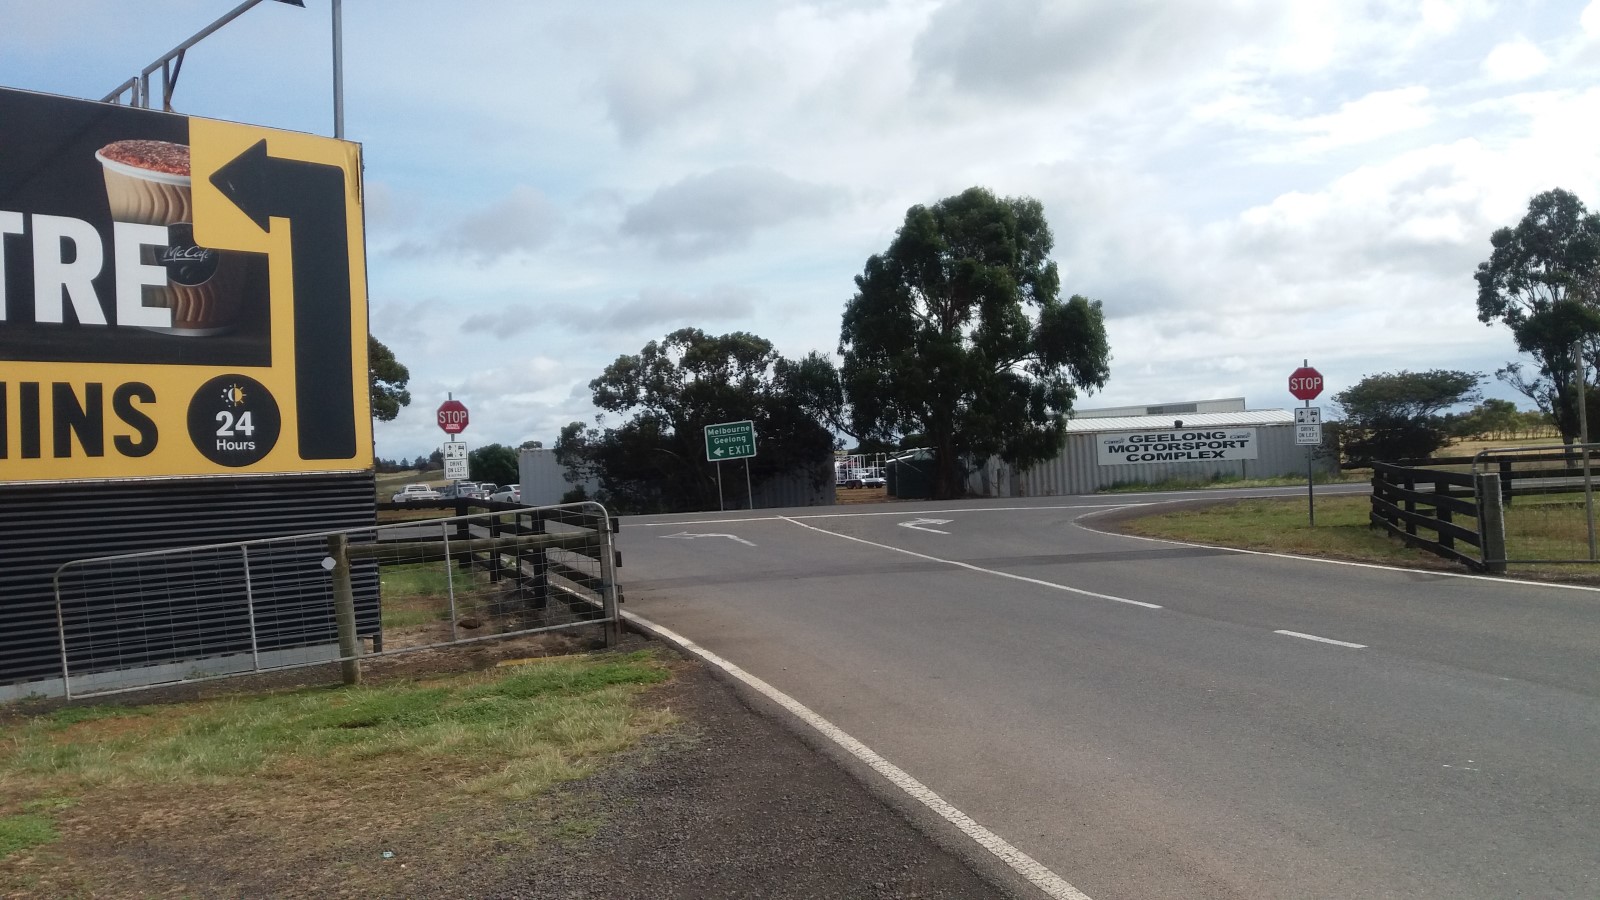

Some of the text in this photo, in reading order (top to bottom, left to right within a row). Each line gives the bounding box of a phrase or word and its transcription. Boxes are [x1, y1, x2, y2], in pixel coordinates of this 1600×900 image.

[1291, 377, 1321, 390] STOP
[0, 381, 158, 458] INS
[215, 410, 255, 436] 24
[439, 410, 467, 424] STOP
[708, 425, 750, 435] Melbourne
[714, 436, 746, 444] Geelong
[1128, 431, 1227, 444] GEELONG
[216, 439, 256, 451] Hours
[728, 444, 751, 455] EXIT
[1108, 440, 1249, 454] MOTORSPORT
[1126, 450, 1226, 462] COMPLEX
